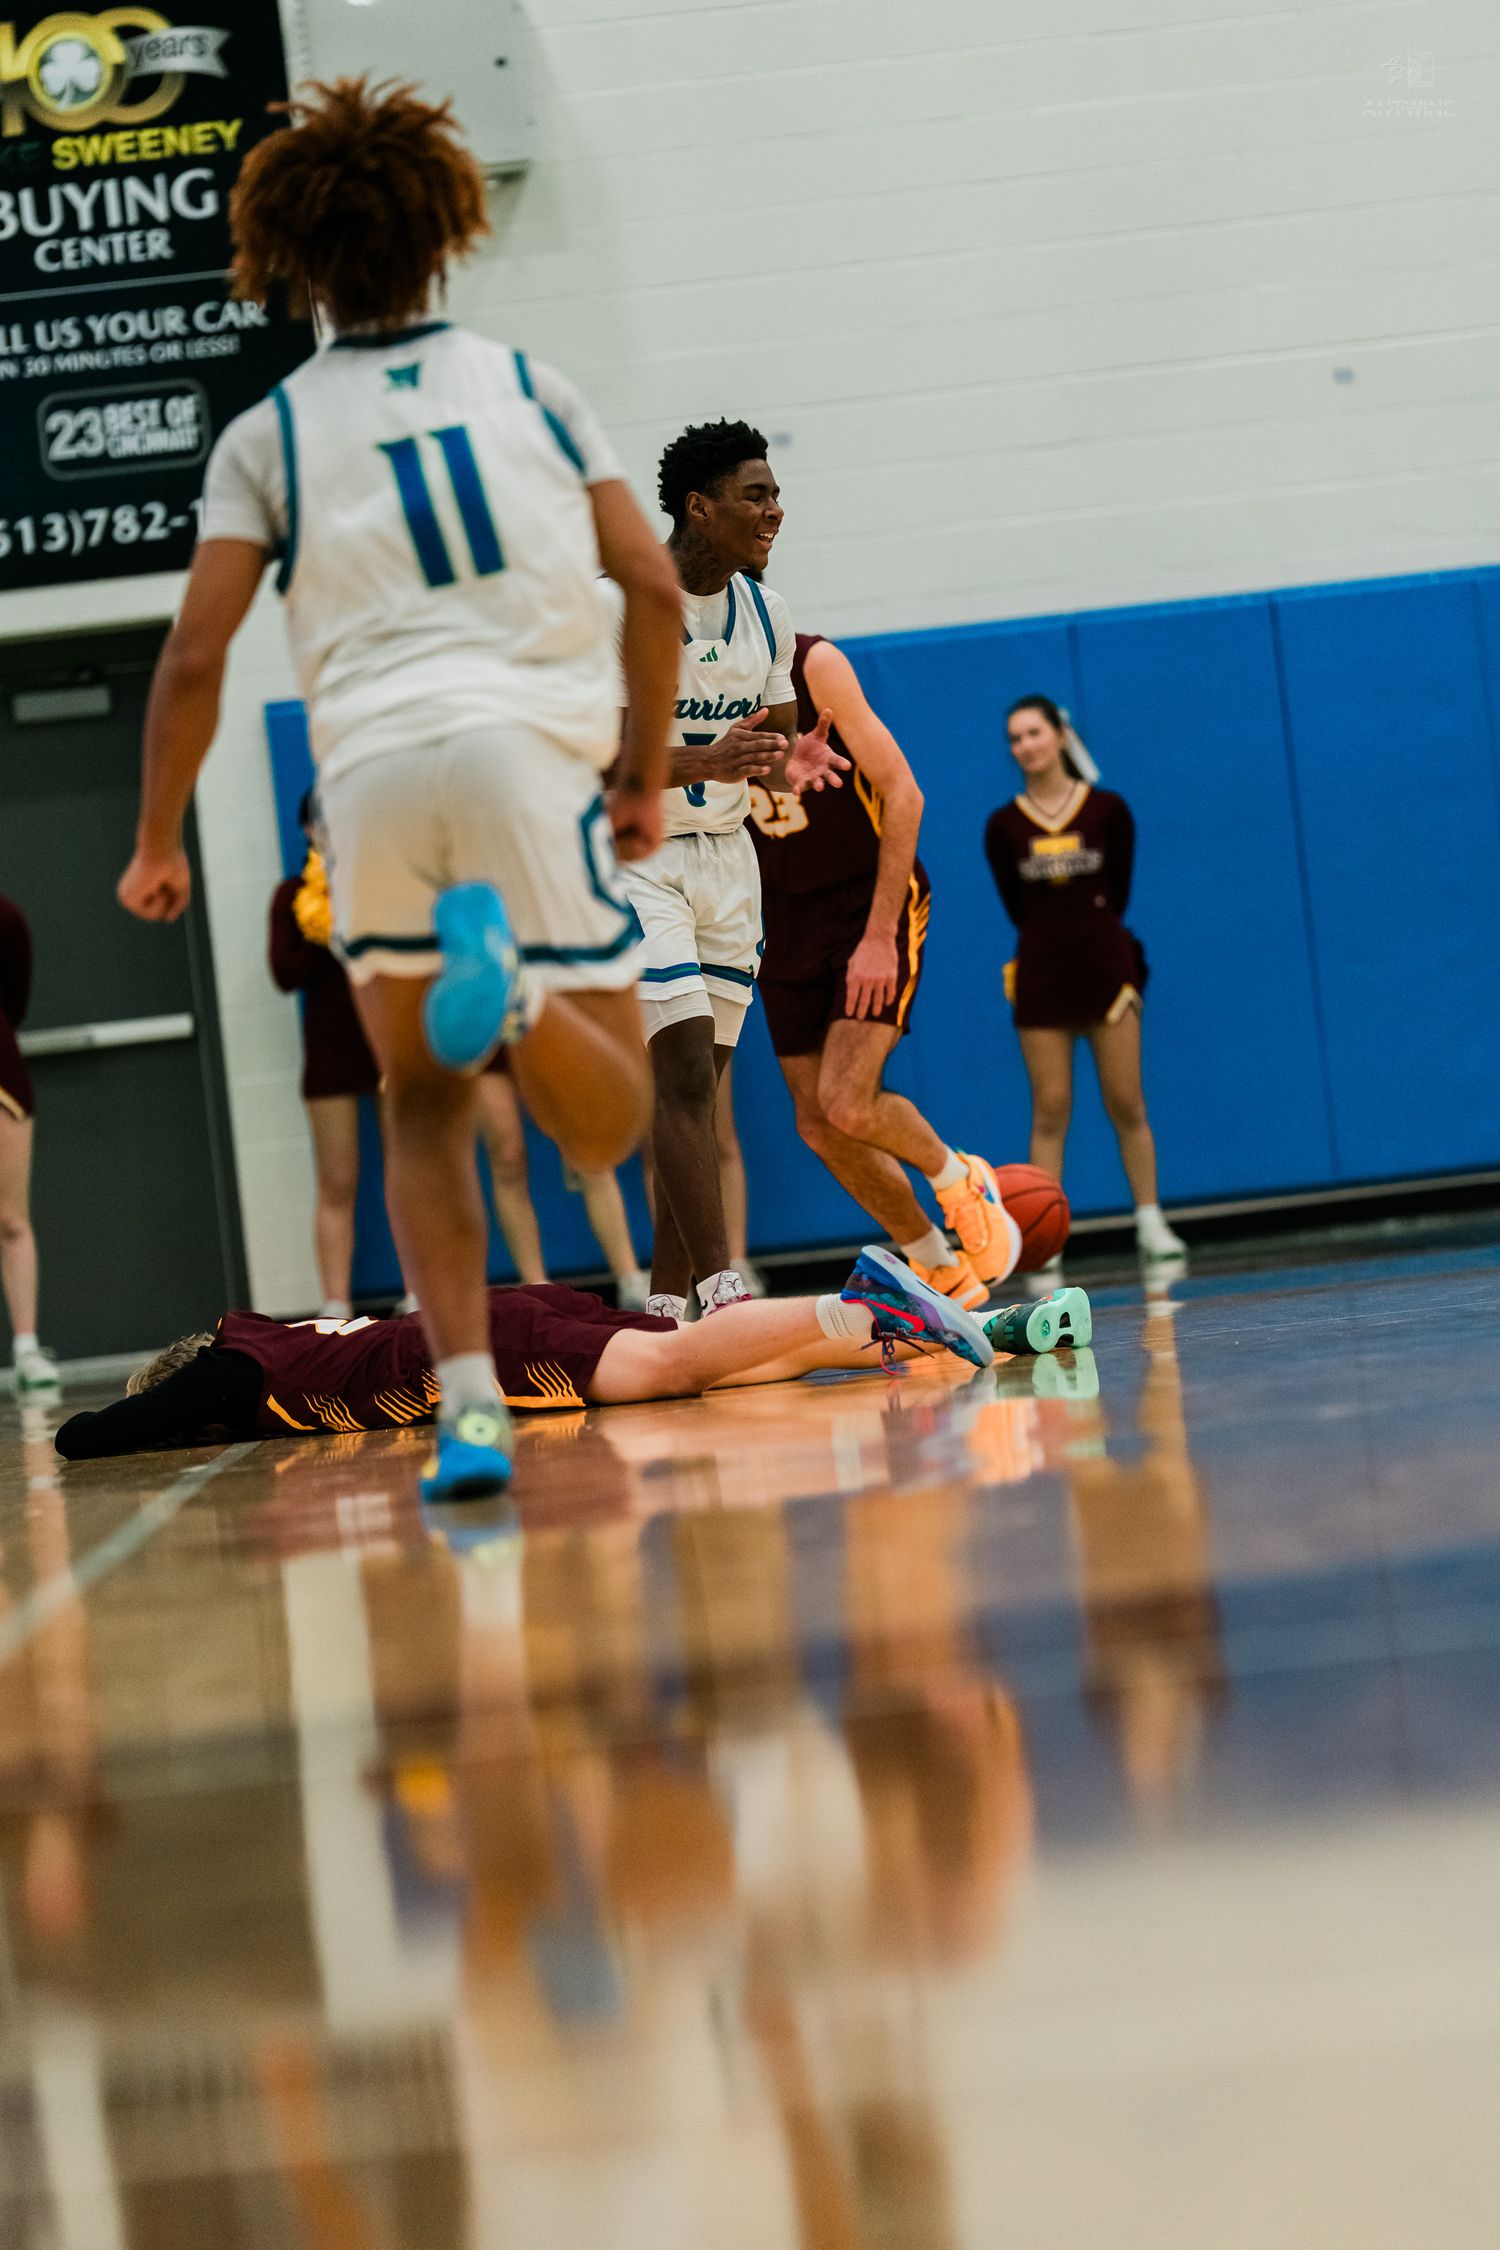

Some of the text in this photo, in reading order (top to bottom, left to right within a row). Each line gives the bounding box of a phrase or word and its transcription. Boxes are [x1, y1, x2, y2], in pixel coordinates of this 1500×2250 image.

[52, 118, 243, 171] SWEENEY
[0, 168, 219, 241] BUYING
[34, 228, 175, 273] CENTER
[34, 316, 82, 351] US
[85, 305, 190, 344] YOUR
[192, 300, 269, 333] CAR
[22, 354, 52, 378] 30
[53, 342, 147, 374] MINUTES
[149, 340, 183, 364] OR
[45, 406, 104, 461] 23
[376, 423, 506, 588] 11
[674, 693, 762, 721] arriors
